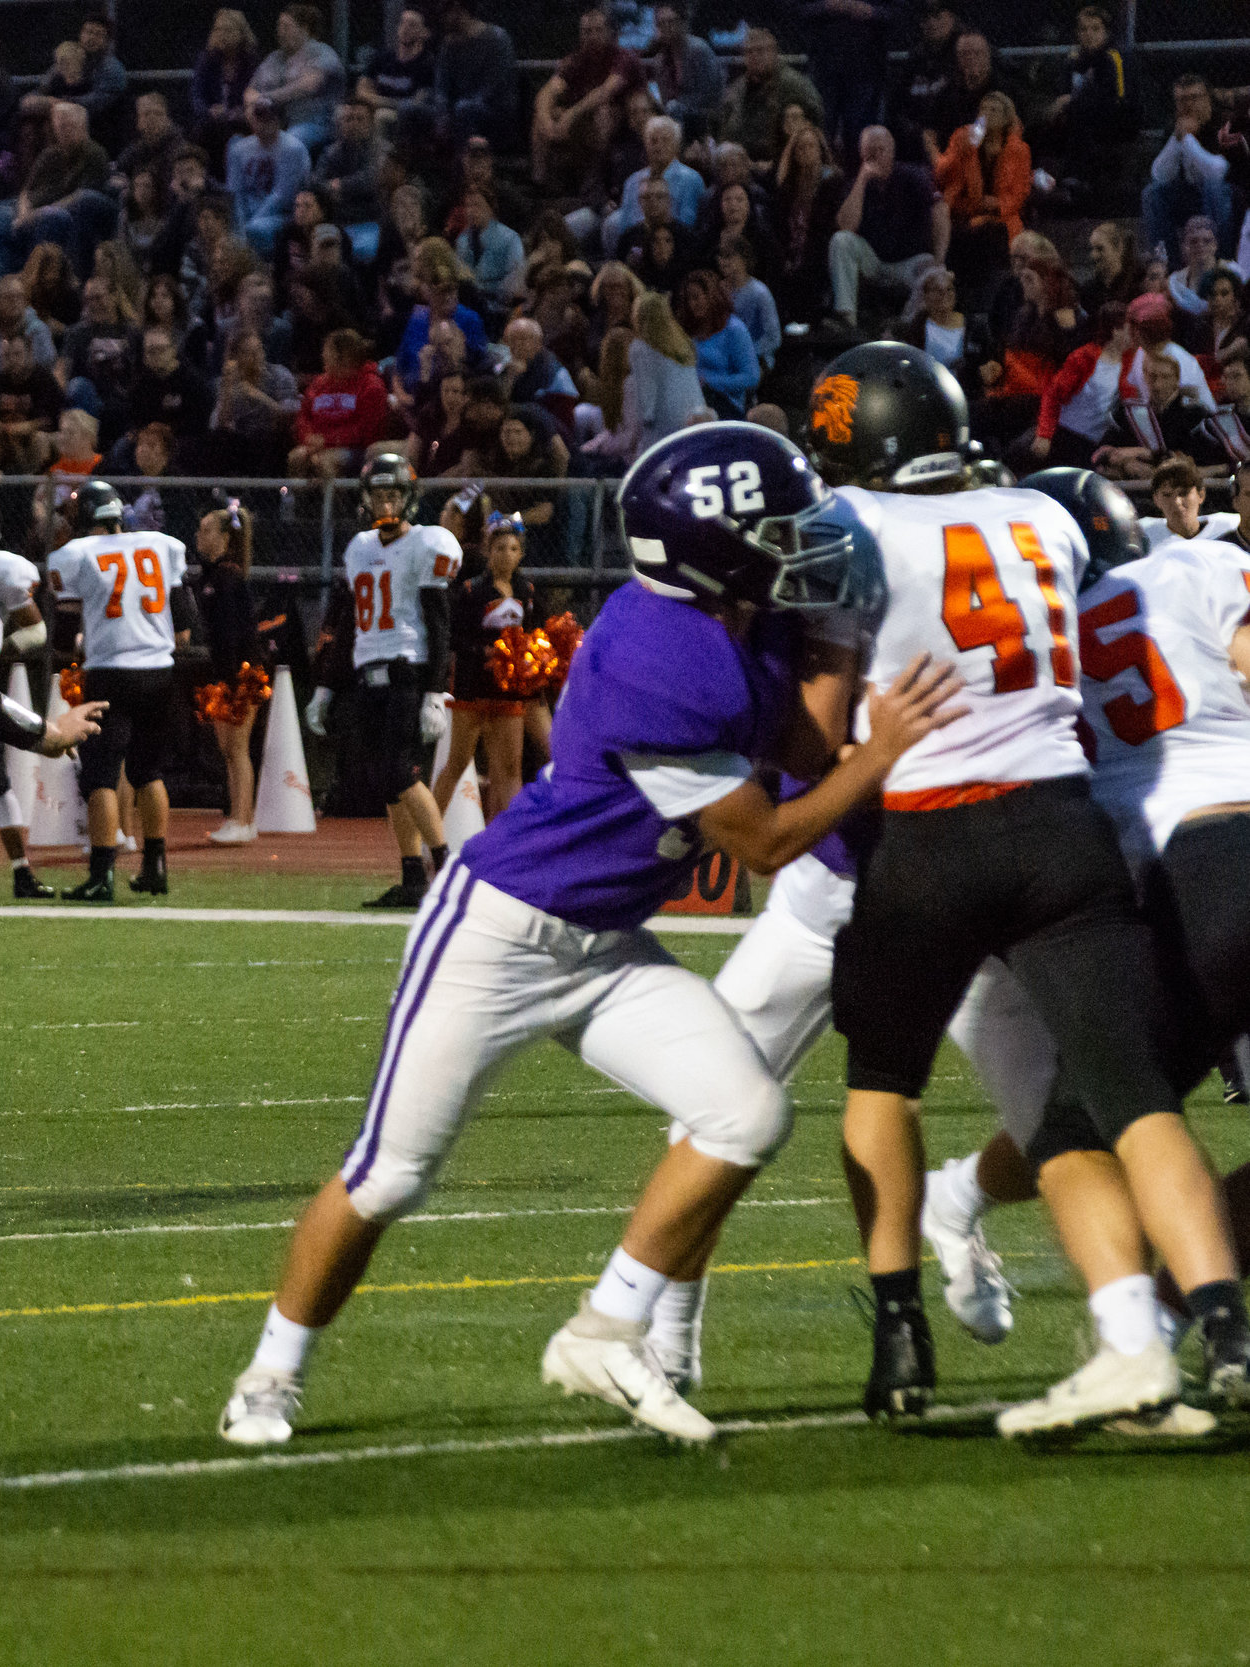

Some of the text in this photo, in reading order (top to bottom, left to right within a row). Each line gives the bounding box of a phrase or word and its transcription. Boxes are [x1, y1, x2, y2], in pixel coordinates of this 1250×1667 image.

[688, 460, 765, 518] 52
[97, 548, 166, 618] 79
[354, 570, 394, 632] 81
[941, 520, 1075, 694] 41
[1073, 590, 1185, 758] 5
